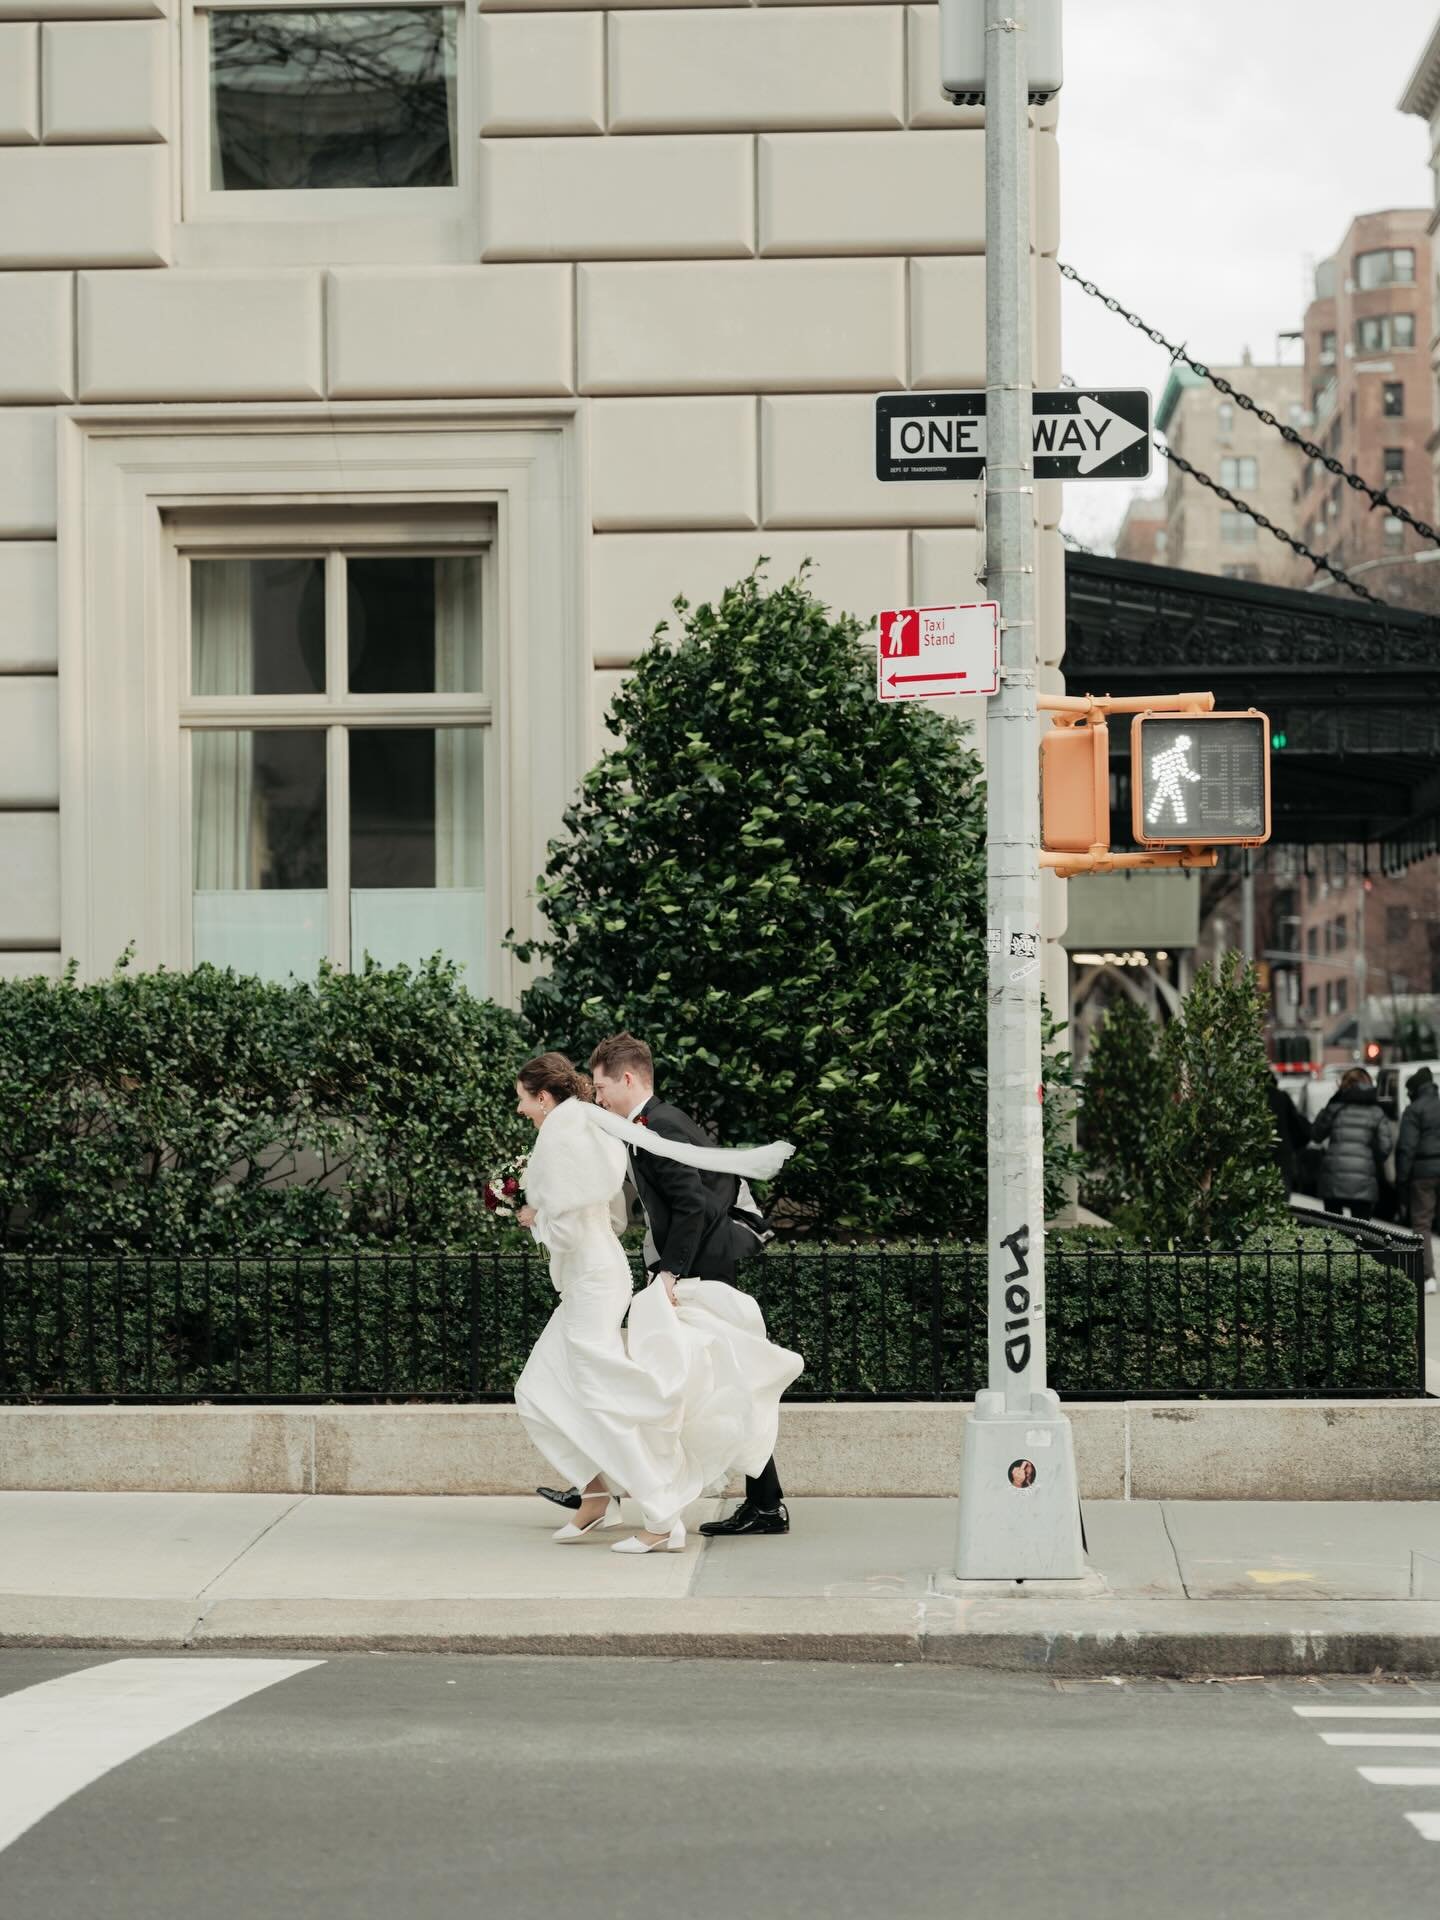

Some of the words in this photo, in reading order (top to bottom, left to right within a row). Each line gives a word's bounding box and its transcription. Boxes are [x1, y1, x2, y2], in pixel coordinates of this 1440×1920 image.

[900, 420, 979, 454] ONE
[1032, 418, 1113, 452] WAY
[923, 618, 946, 632] Taxi
[923, 633, 956, 647] Stand
